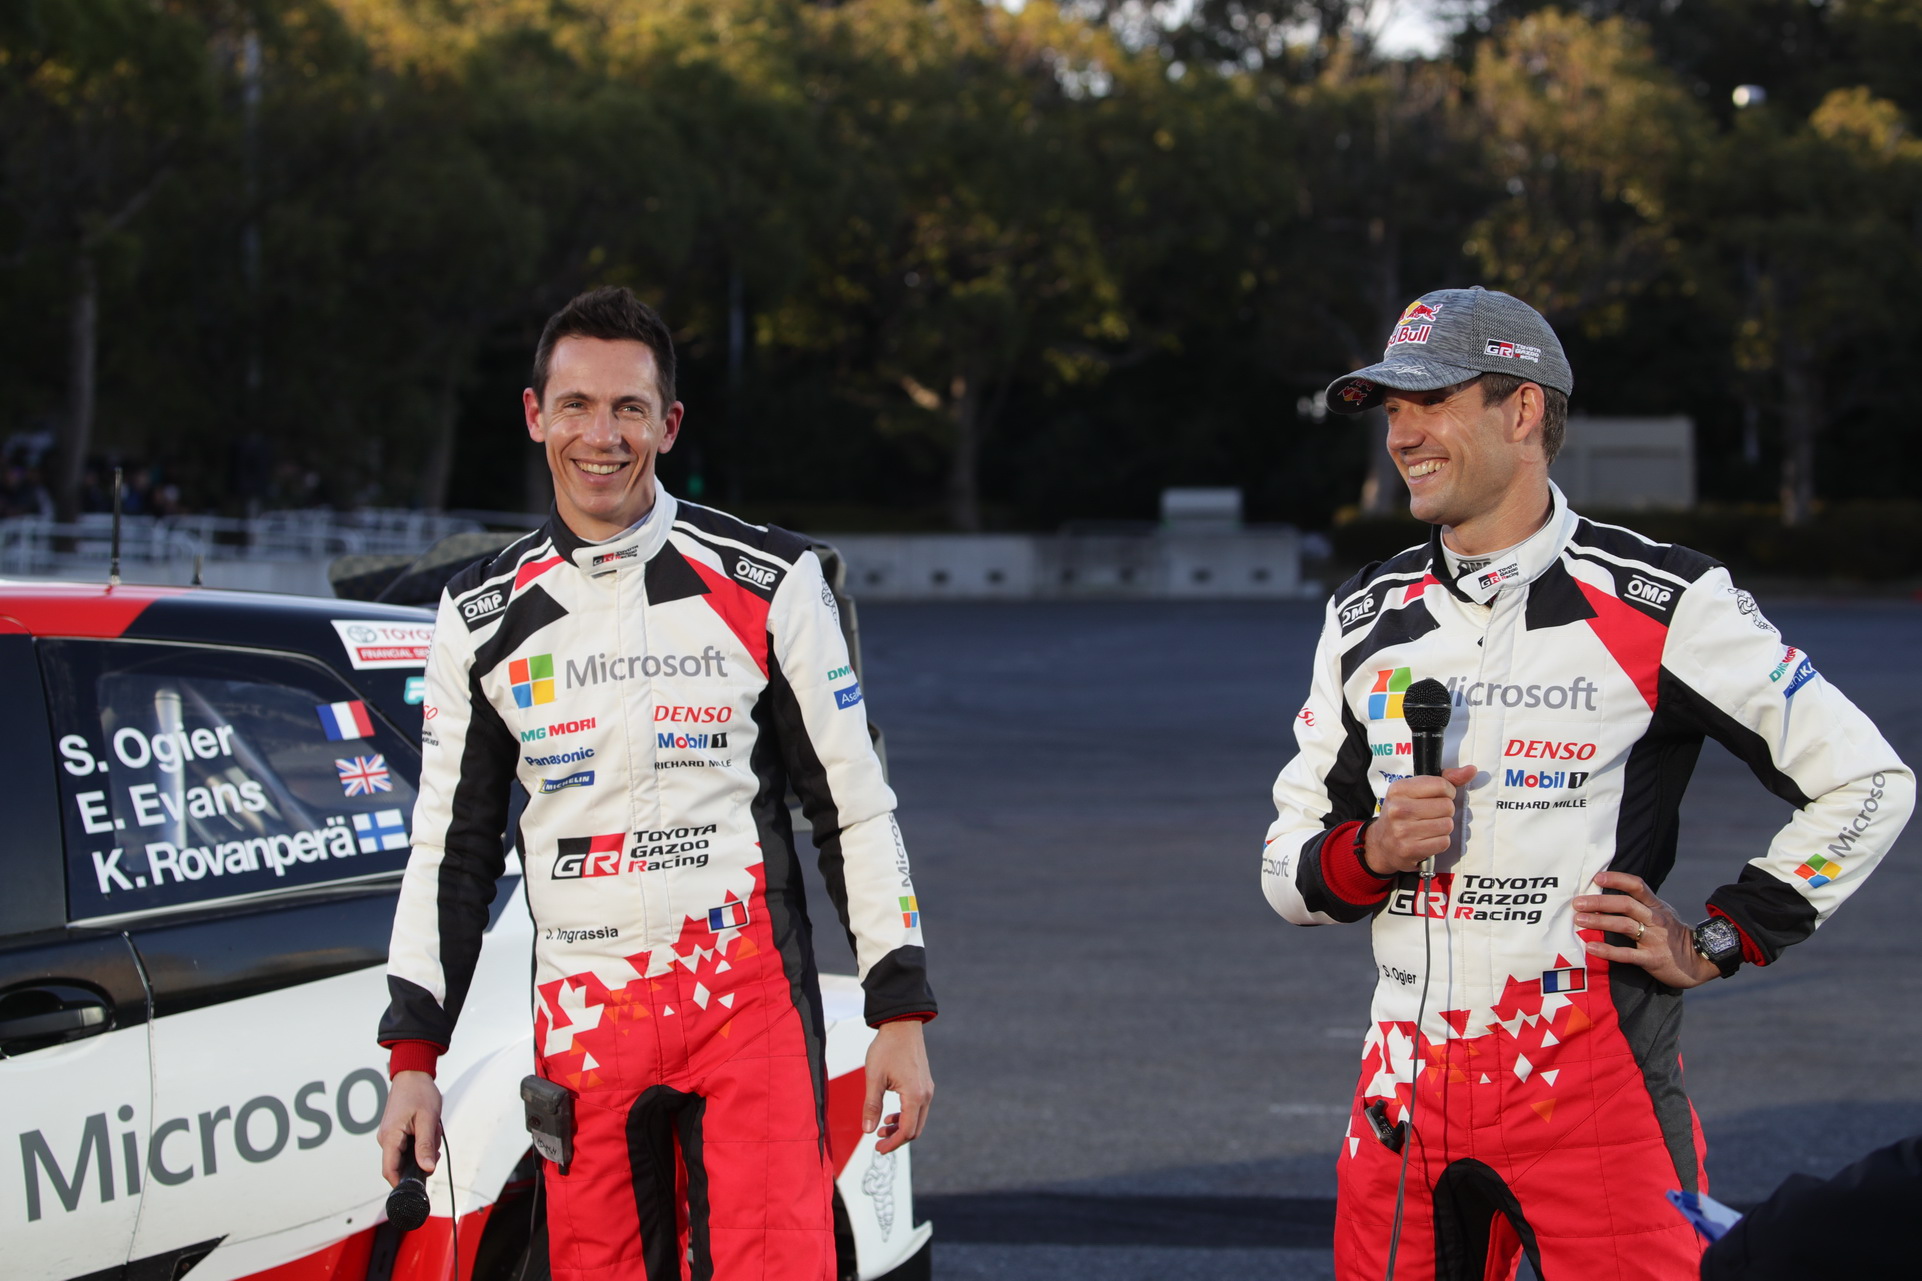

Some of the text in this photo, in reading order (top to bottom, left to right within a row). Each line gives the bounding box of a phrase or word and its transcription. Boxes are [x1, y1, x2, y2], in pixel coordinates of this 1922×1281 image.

[1397, 325, 1432, 343] Bull
[1485, 341, 1513, 358] GR
[736, 561, 775, 585] OMP
[1480, 574, 1501, 589] GR
[1627, 579, 1671, 604] OMP
[465, 594, 502, 617] OMP
[379, 628, 432, 640] TOYO
[566, 646, 728, 689] Microsoft
[827, 665, 851, 681] DM
[653, 705, 732, 723] DENSO
[520, 717, 596, 742] MG MORI
[59, 722, 234, 777] S. Ogier
[658, 733, 725, 749] Mobil 1
[1371, 743, 1393, 756] MG
[1504, 739, 1597, 760] DENSO
[524, 747, 595, 766] Panasonic
[654, 760, 704, 770] RICHARD
[546, 776, 590, 790] MICHELIN
[1505, 769, 1565, 788] Mobil
[76, 776, 267, 835] E. Evans
[1496, 799, 1586, 810] RICHARD MILLE
[1827, 771, 1886, 858] Microso
[634, 824, 717, 843] TOYOTA
[91, 816, 355, 894] K. Rovanperä
[631, 840, 709, 858] GAZOO
[888, 812, 911, 888] Micros
[553, 850, 620, 877] GR
[628, 854, 708, 873] Racing
[1463, 875, 1558, 889] TOYOTA
[1391, 889, 1447, 918] GR
[1457, 891, 1547, 905] GAZOO
[1454, 906, 1542, 924] Racing
[557, 926, 618, 943] Ingrassia
[1382, 964, 1417, 985] S. Ogier
[19, 1063, 389, 1222] Microso
